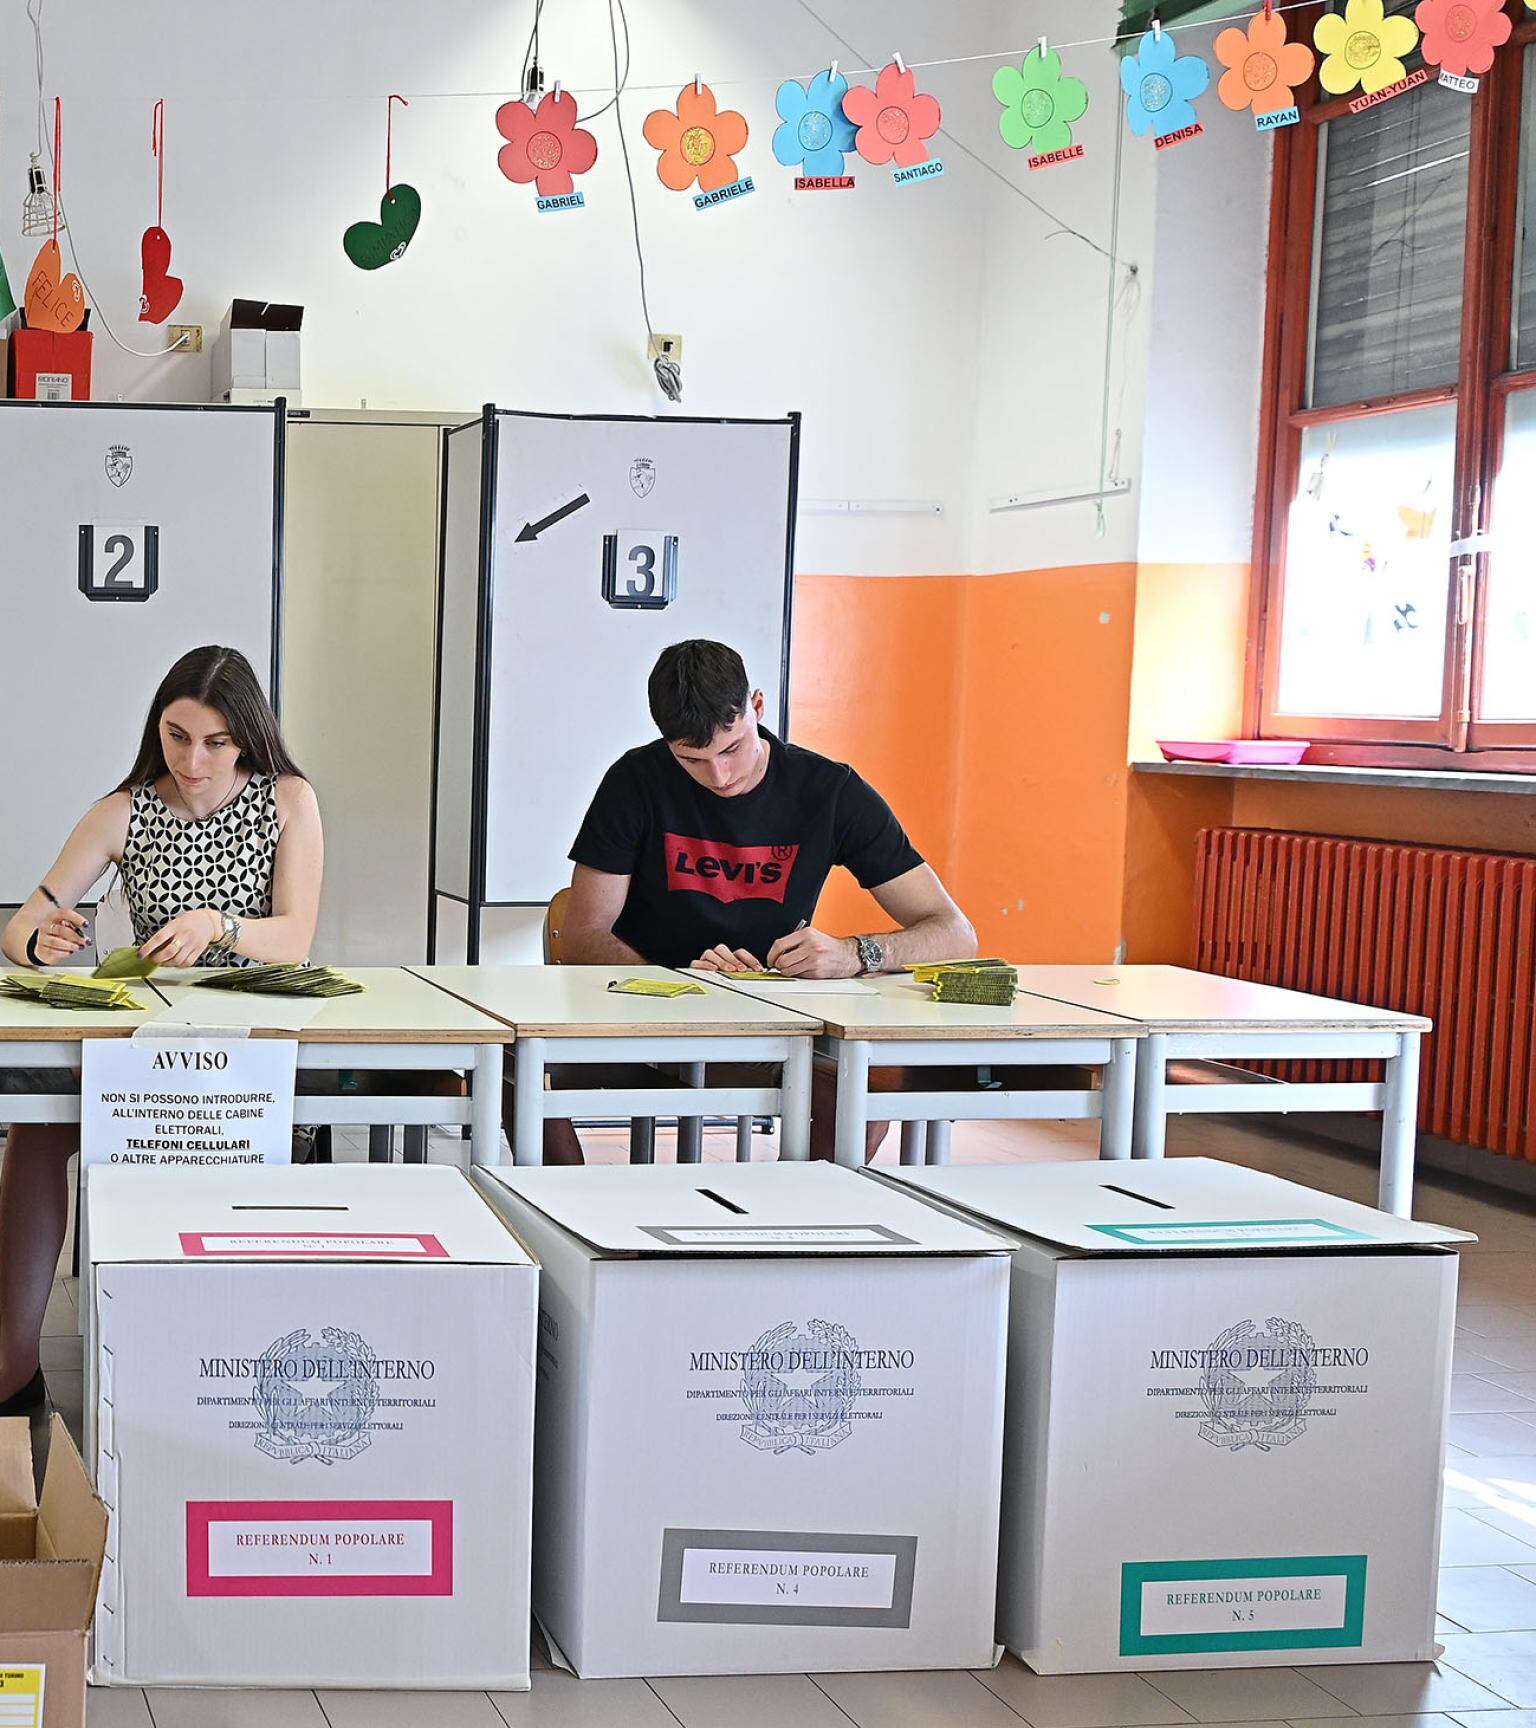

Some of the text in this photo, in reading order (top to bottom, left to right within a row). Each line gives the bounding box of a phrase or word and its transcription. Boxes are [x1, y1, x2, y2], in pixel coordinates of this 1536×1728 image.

[1351, 72, 1425, 111] YUAN-YUAN
[1257, 110, 1297, 127] RAYAN
[1155, 124, 1203, 148] DENISA
[1028, 146, 1084, 167] ISABELLE
[894, 163, 943, 183] SANTIAGO
[795, 177, 855, 189] ISABELLA
[695, 180, 755, 208] GABRIELE
[537, 197, 584, 210] GABRIEL
[32, 270, 74, 327] FELICE
[104, 535, 134, 588] 2
[626, 545, 656, 596] 3
[152, 1051, 228, 1070] AVVISO
[102, 1093, 275, 1104] NON SI POSSONO INTRODURRE,
[112, 1108, 264, 1120] ALL'INTERNO DELLE CABINE
[126, 1139, 250, 1150] TELEFONI CELLULARI
[110, 1153, 265, 1165] O ALTRE APPARECCHIATURE
[689, 1350, 914, 1371] MINISTERO DELL'INTERNO
[1150, 1348, 1369, 1369] MINISTERO DELL'INTERNO
[199, 1358, 435, 1380] MINISTERO DELL'INTERNO
[856, 1388, 914, 1397] TERRITORIALI
[1313, 1386, 1368, 1394] TERRITORIALI
[377, 1398, 436, 1407] TERRITORIALI
[236, 1533, 405, 1546] REFERENDUM POPOLARE
[308, 1553, 332, 1565] N. 1
[709, 1562, 869, 1578] REFERENDUM POPOLARE
[776, 1583, 799, 1595] N. 4
[1167, 1588, 1322, 1605] REFERENDUM POPOLARE
[1232, 1609, 1254, 1621] N. 5
